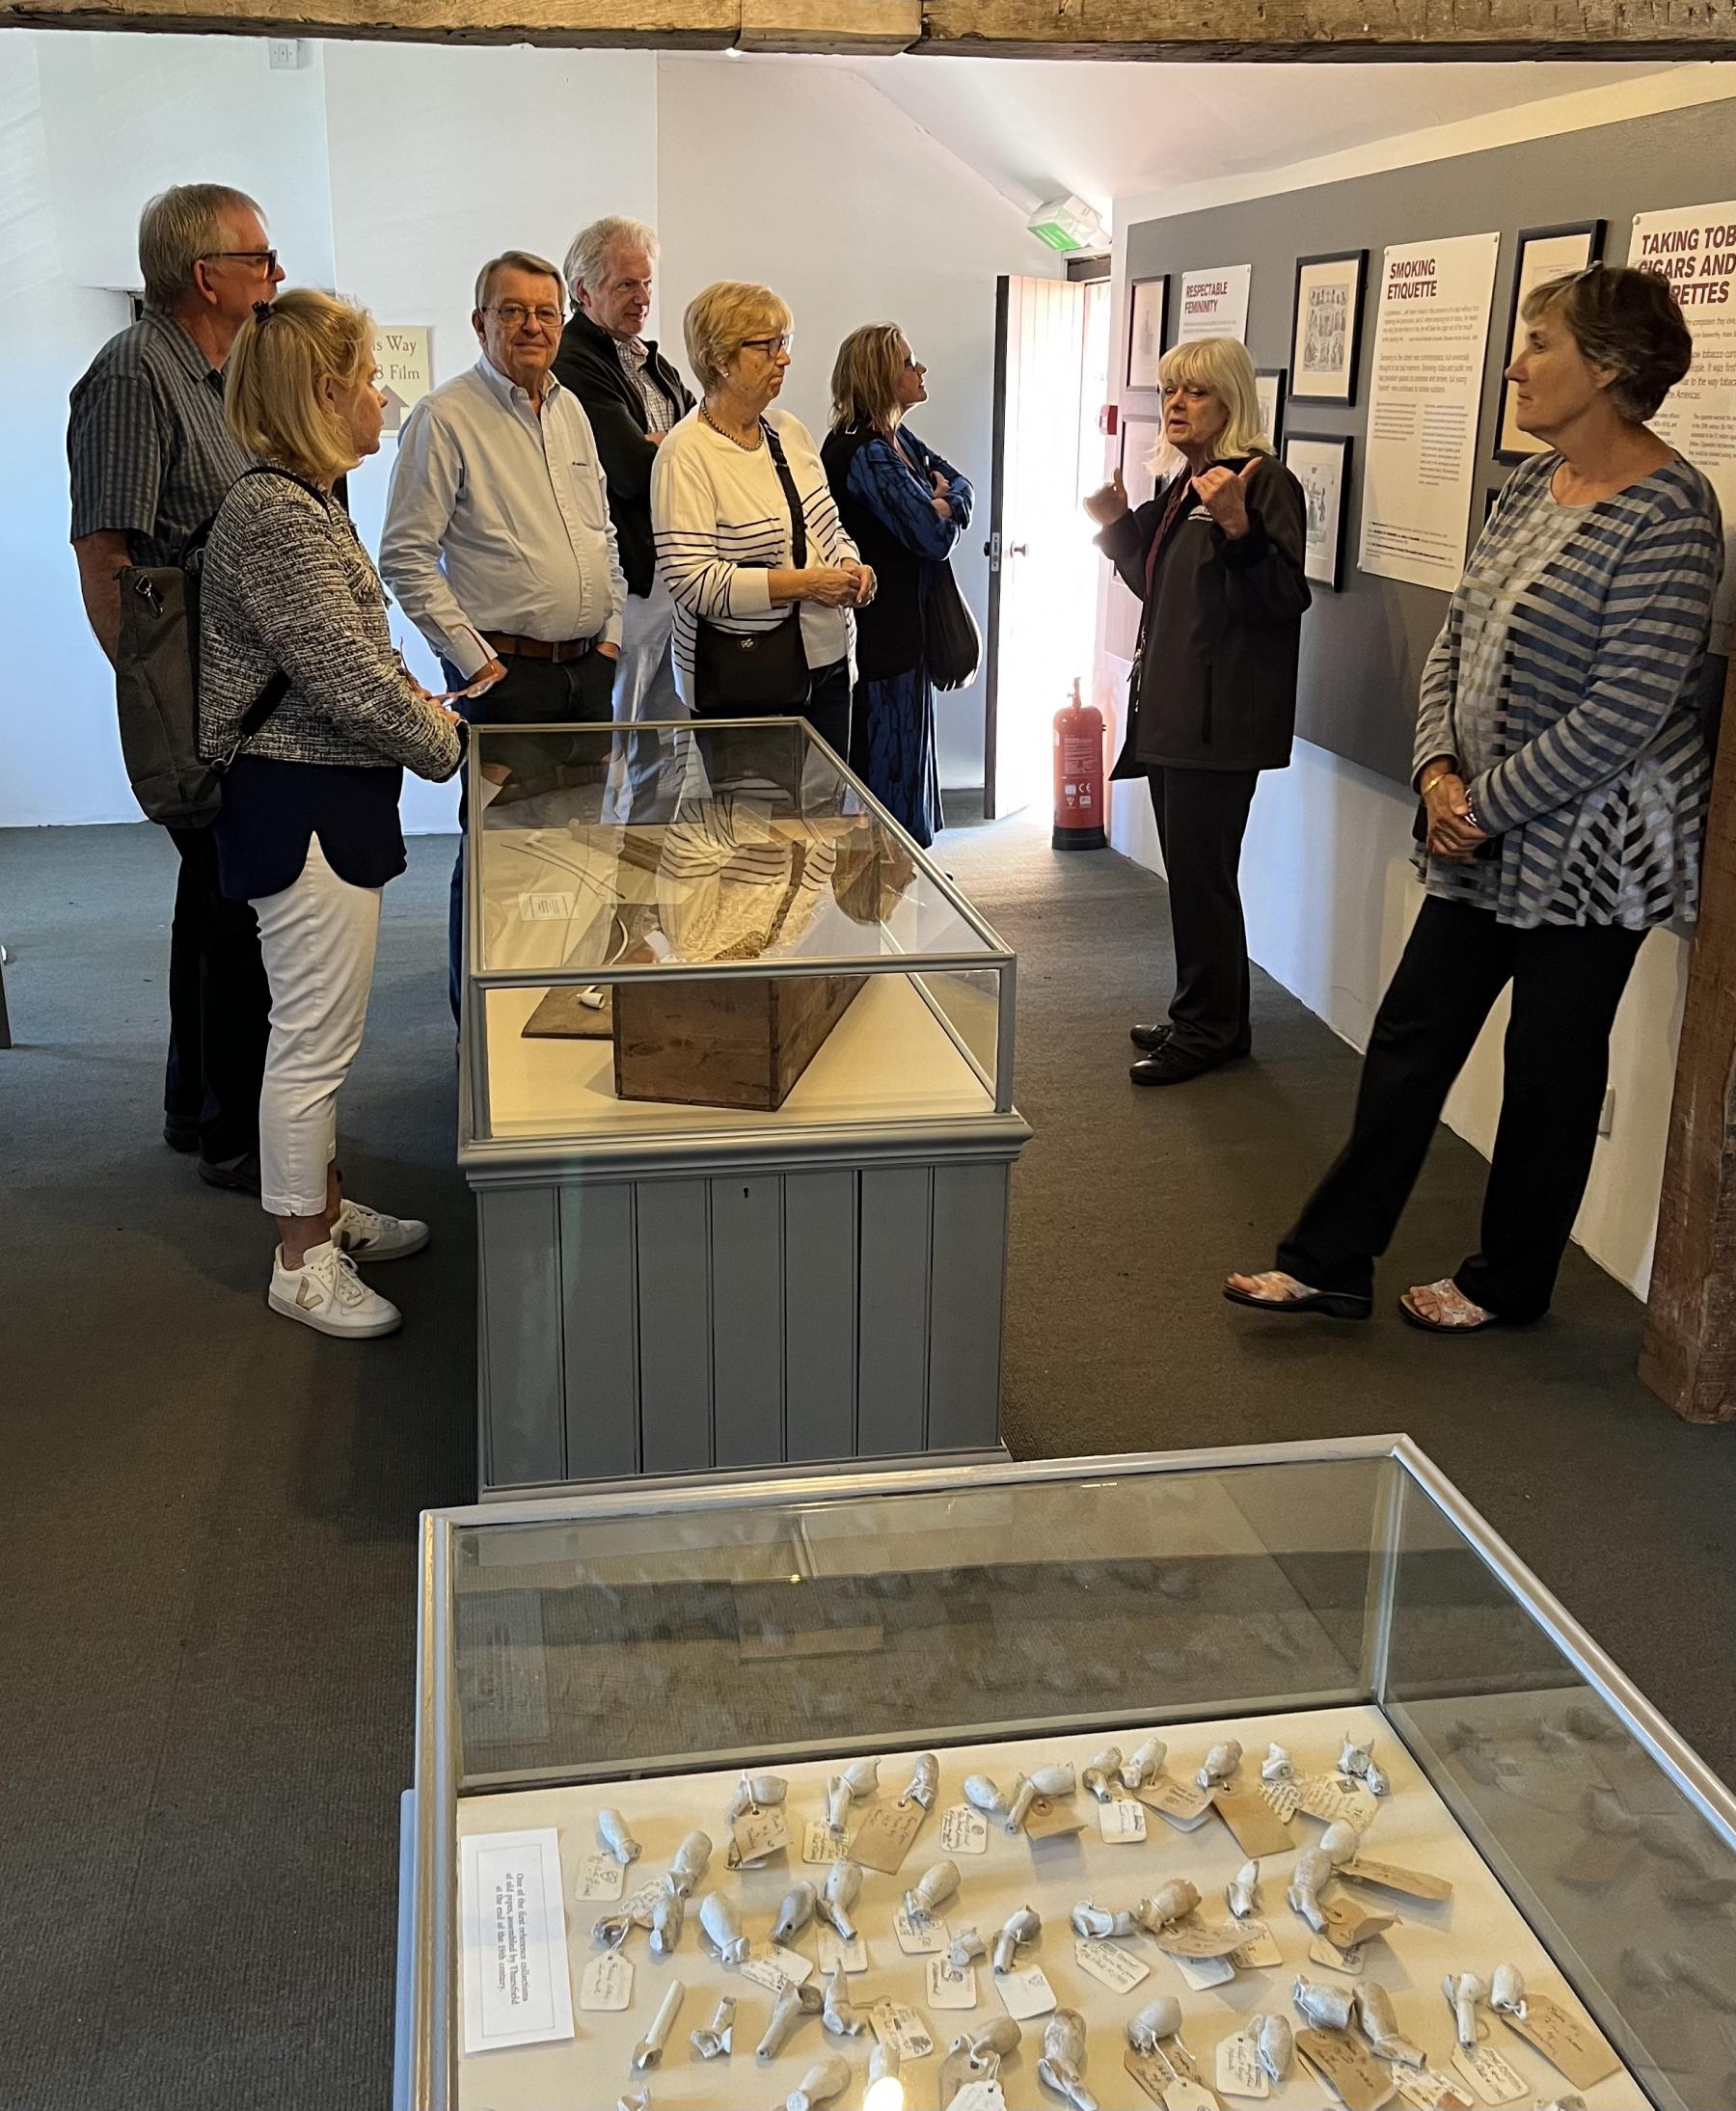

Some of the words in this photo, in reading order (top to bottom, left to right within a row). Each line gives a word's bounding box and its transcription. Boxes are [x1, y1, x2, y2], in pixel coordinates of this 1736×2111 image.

[1642, 229, 1699, 256] TAKING
[1389, 257, 1436, 280] SMOKING
[1698, 253, 1736, 277] AND
[1186, 282, 1228, 297] RESPECTABLE
[1387, 280, 1438, 301] ETIQUETTE
[1669, 281, 1730, 305] RETTES
[1184, 298, 1219, 314] FEMININITY
[372, 338, 383, 352] is
[386, 335, 417, 357] Way
[390, 364, 420, 380] Film
[516, 1873, 525, 1887] One
[496, 1894, 505, 1905] the
[517, 1897, 526, 1909] the
[497, 1907, 505, 1920] end
[518, 1910, 527, 1925] first
[497, 1921, 505, 1930] of
[498, 1931, 506, 1942] the
[507, 1953, 518, 1963] by
[521, 1962, 529, 2002] collections
